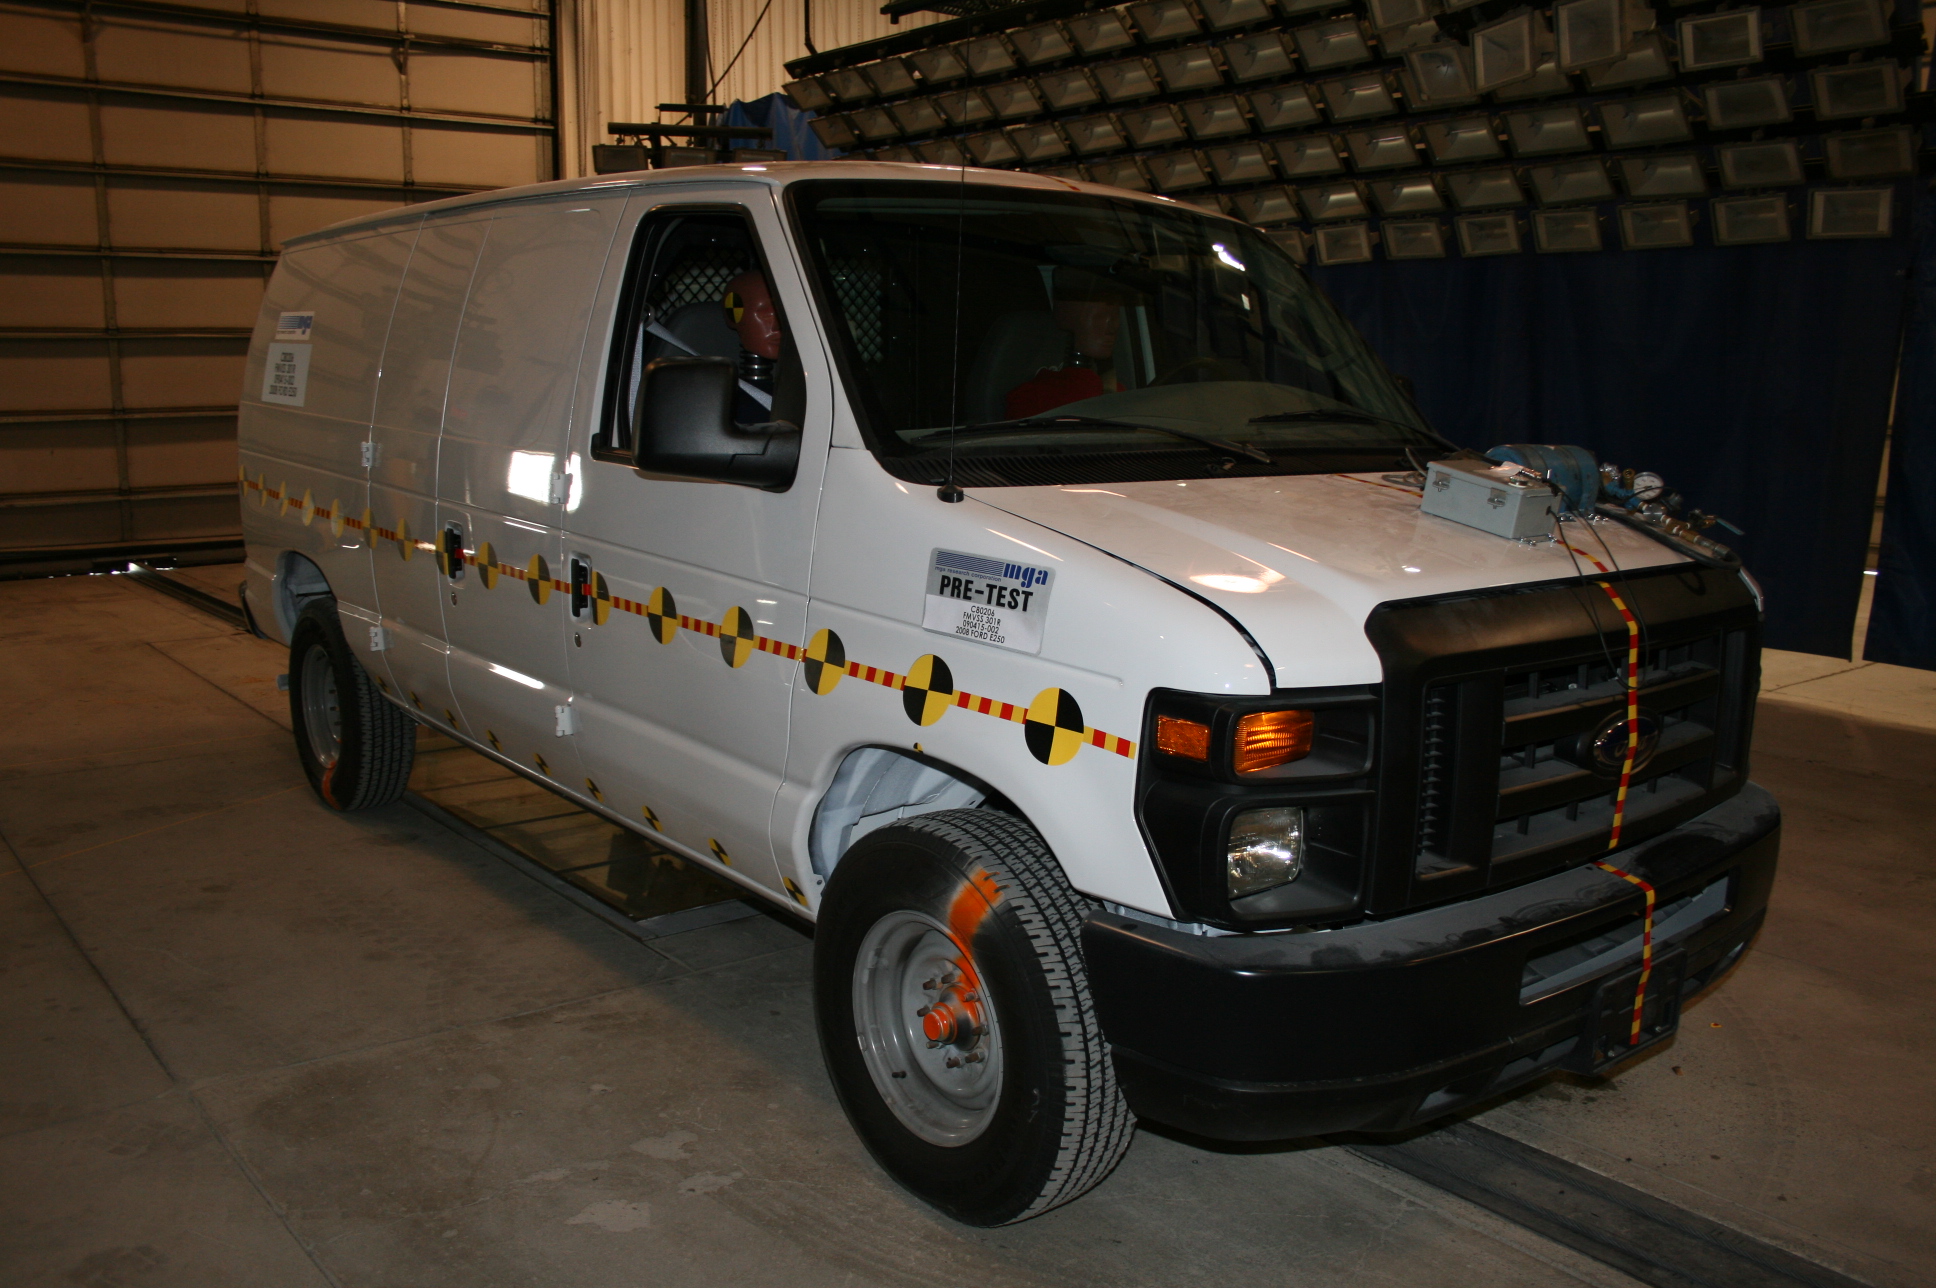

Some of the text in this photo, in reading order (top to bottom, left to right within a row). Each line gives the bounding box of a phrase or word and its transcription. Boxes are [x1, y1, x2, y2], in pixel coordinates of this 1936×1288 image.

[947, 568, 970, 576] research
[971, 572, 1002, 582] corporation
[1003, 563, 1048, 588] mga
[939, 575, 1033, 612] PRE-TEST
[963, 612, 1001, 627] FMVSS 301R
[963, 620, 1000, 634] 090415-002
[955, 626, 1005, 644] 2008 FORD E250
